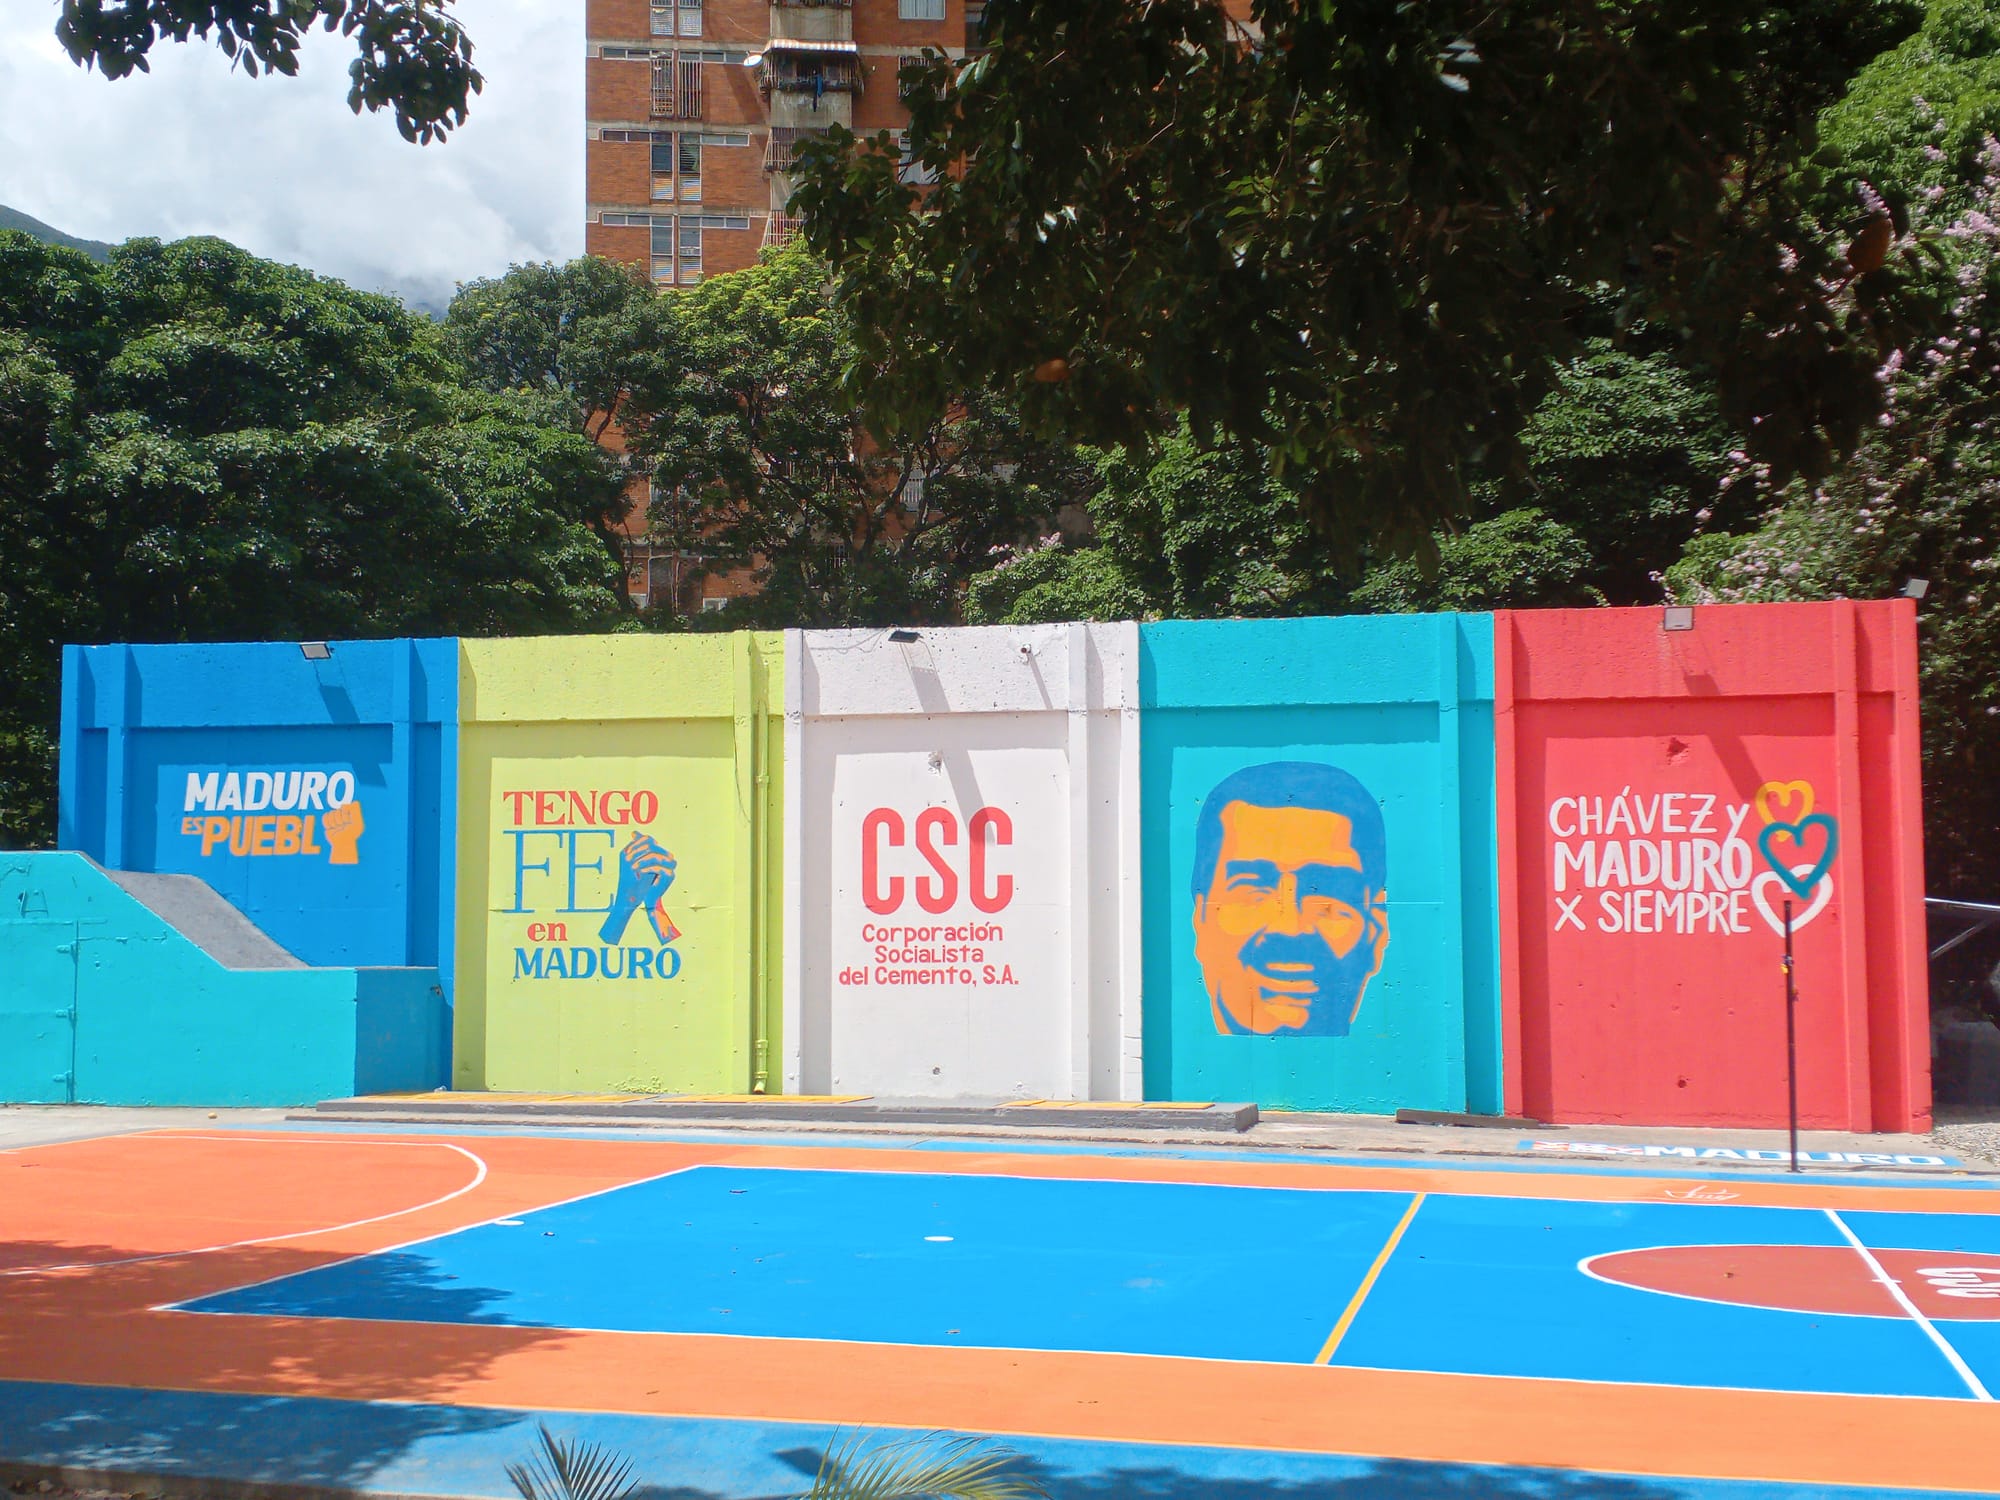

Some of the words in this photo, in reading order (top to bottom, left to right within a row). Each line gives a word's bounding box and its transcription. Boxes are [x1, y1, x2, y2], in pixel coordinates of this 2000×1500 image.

[183, 770, 355, 812] MADURO
[503, 790, 659, 825] TENGO
[181, 816, 205, 835] ES
[1549, 785, 1718, 837] CHÁVEZ
[502, 829, 615, 913] FE
[862, 806, 1013, 915] CSC
[1554, 837, 1753, 892] MADURO
[1597, 889, 1752, 936] SIEMPRE
[527, 922, 568, 942] en
[862, 921, 1004, 948] Corporación
[513, 947, 682, 980] MADURO
[838, 966, 869, 985] del
[874, 965, 977, 988] Cemento,
[982, 964, 1019, 985] S.A.
[1643, 1145, 1946, 1166] MADURO
